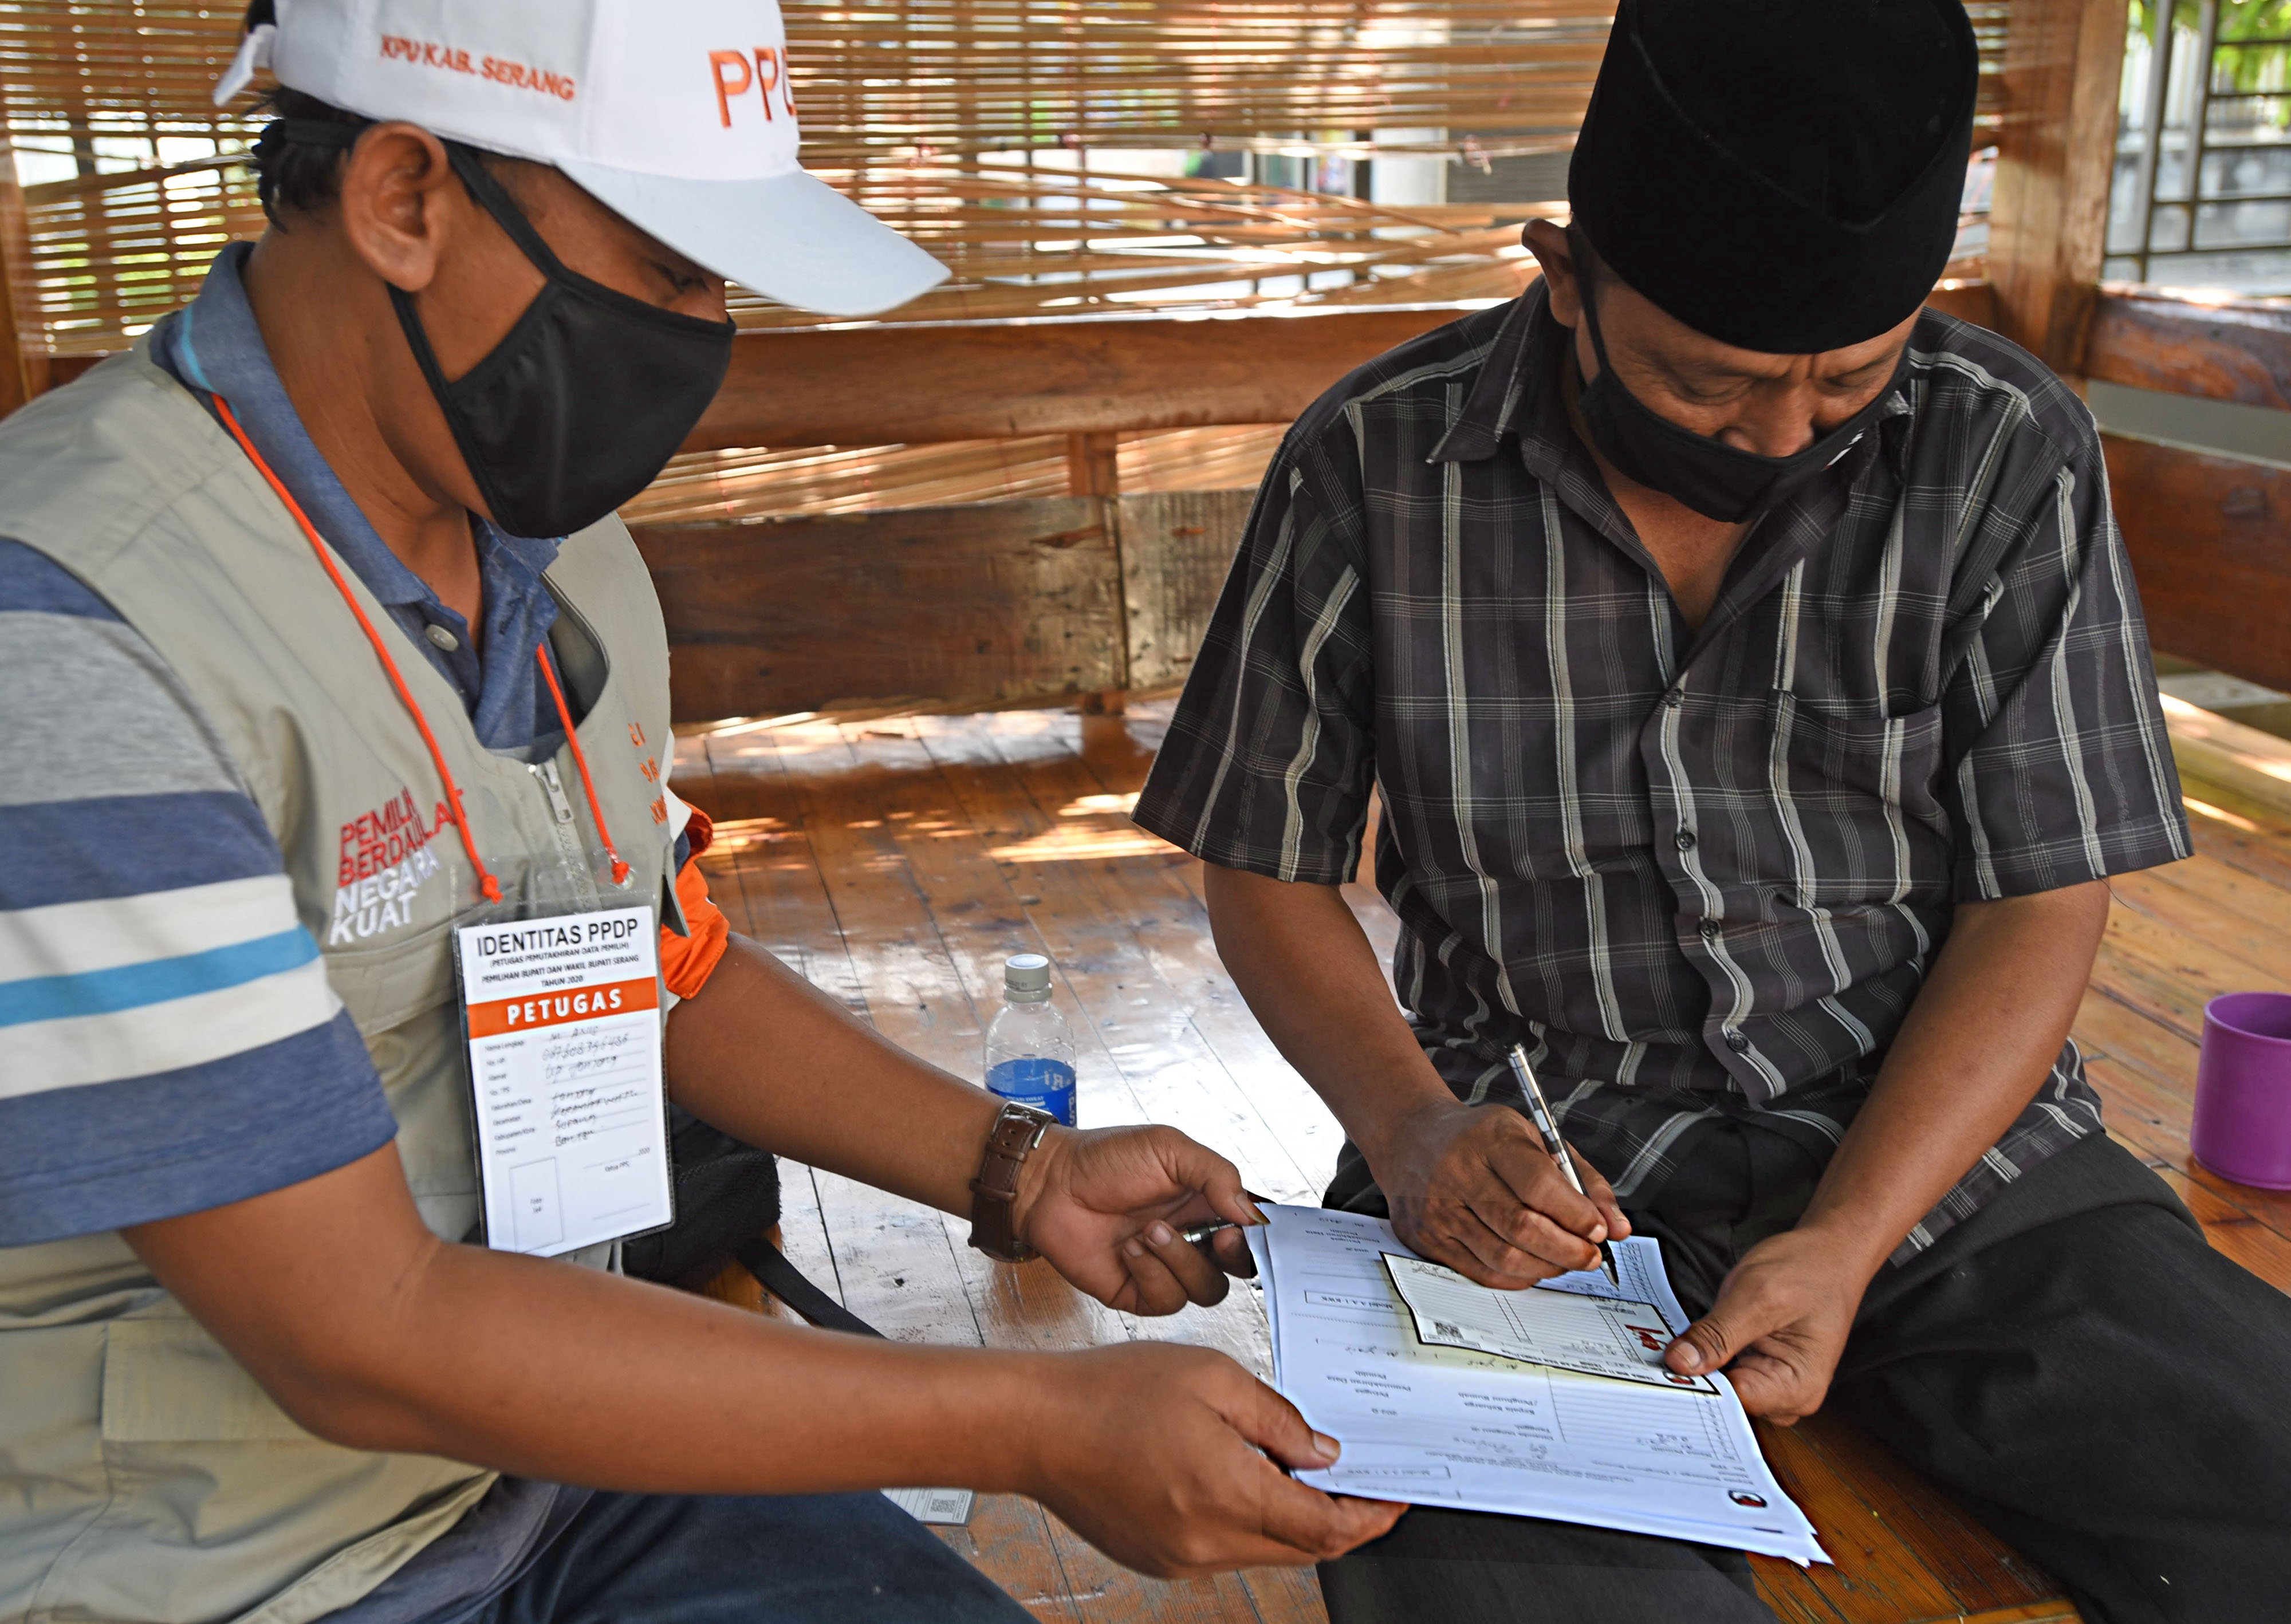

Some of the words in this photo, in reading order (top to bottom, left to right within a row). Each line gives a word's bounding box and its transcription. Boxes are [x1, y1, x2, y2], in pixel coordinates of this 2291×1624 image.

[380, 33, 421, 64] KPU
[424, 42, 477, 76] KAB.
[481, 55, 575, 101] SERANG
[334, 845, 441, 917] NEGARA
[329, 889, 417, 946] KUAT
[477, 925, 581, 957] IDENTITAS
[588, 918, 638, 943] PPDP
[525, 949, 580, 961] PEMUTAKHIRAN
[582, 946, 600, 955] DATA
[481, 972, 520, 984] PEMILIHAN
[521, 967, 545, 977] BUPATI
[547, 965, 562, 974] DAN
[564, 961, 586, 972] WAKIL
[588, 959, 612, 969] BUPATI
[613, 955, 640, 965] SERANG
[541, 977, 565, 988] TAHUN
[507, 988, 623, 1026] PETUGAS
[1369, 1302, 1394, 1310] Model
[1326, 1376, 1348, 1384] Data
[1354, 1388, 1389, 1398] Petugas
[1464, 1402, 1503, 1412] Keluarga
[1505, 1406, 1535, 1415] Kepala
